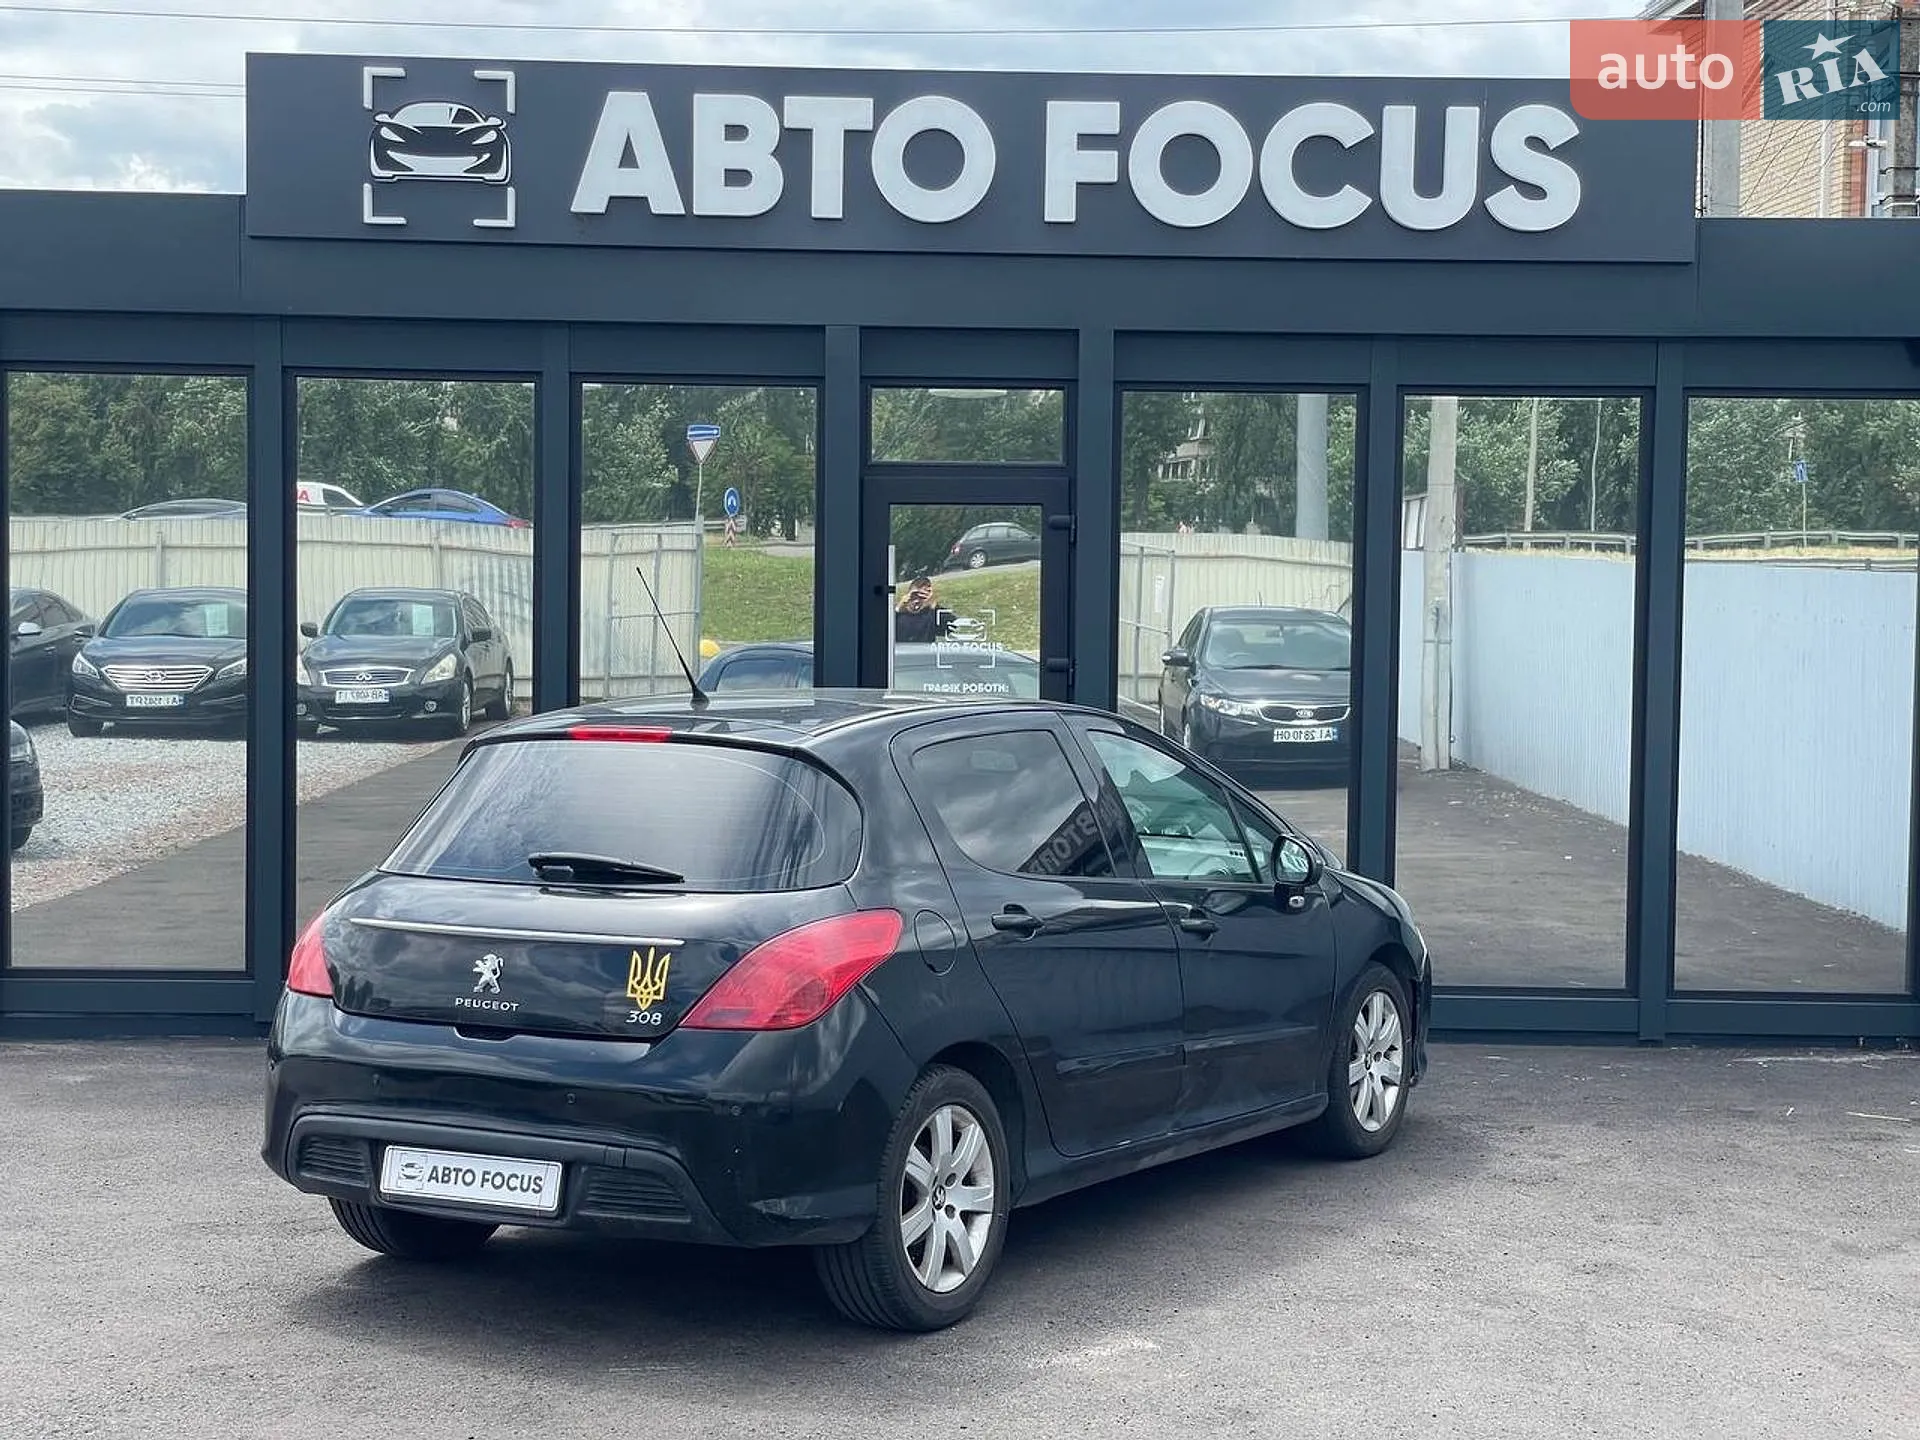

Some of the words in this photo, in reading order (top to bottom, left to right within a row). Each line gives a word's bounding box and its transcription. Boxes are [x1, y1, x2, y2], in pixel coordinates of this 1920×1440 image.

[570, 91, 996, 223] АВТО
[1044, 100, 1581, 231] FOCUS
[963, 642, 1003, 653] FOCUS
[455, 997, 520, 1012] PEUGEOT
[626, 1010, 663, 1026] 308
[427, 1165, 476, 1187] АВТО
[480, 1170, 543, 1194] FOCUS
